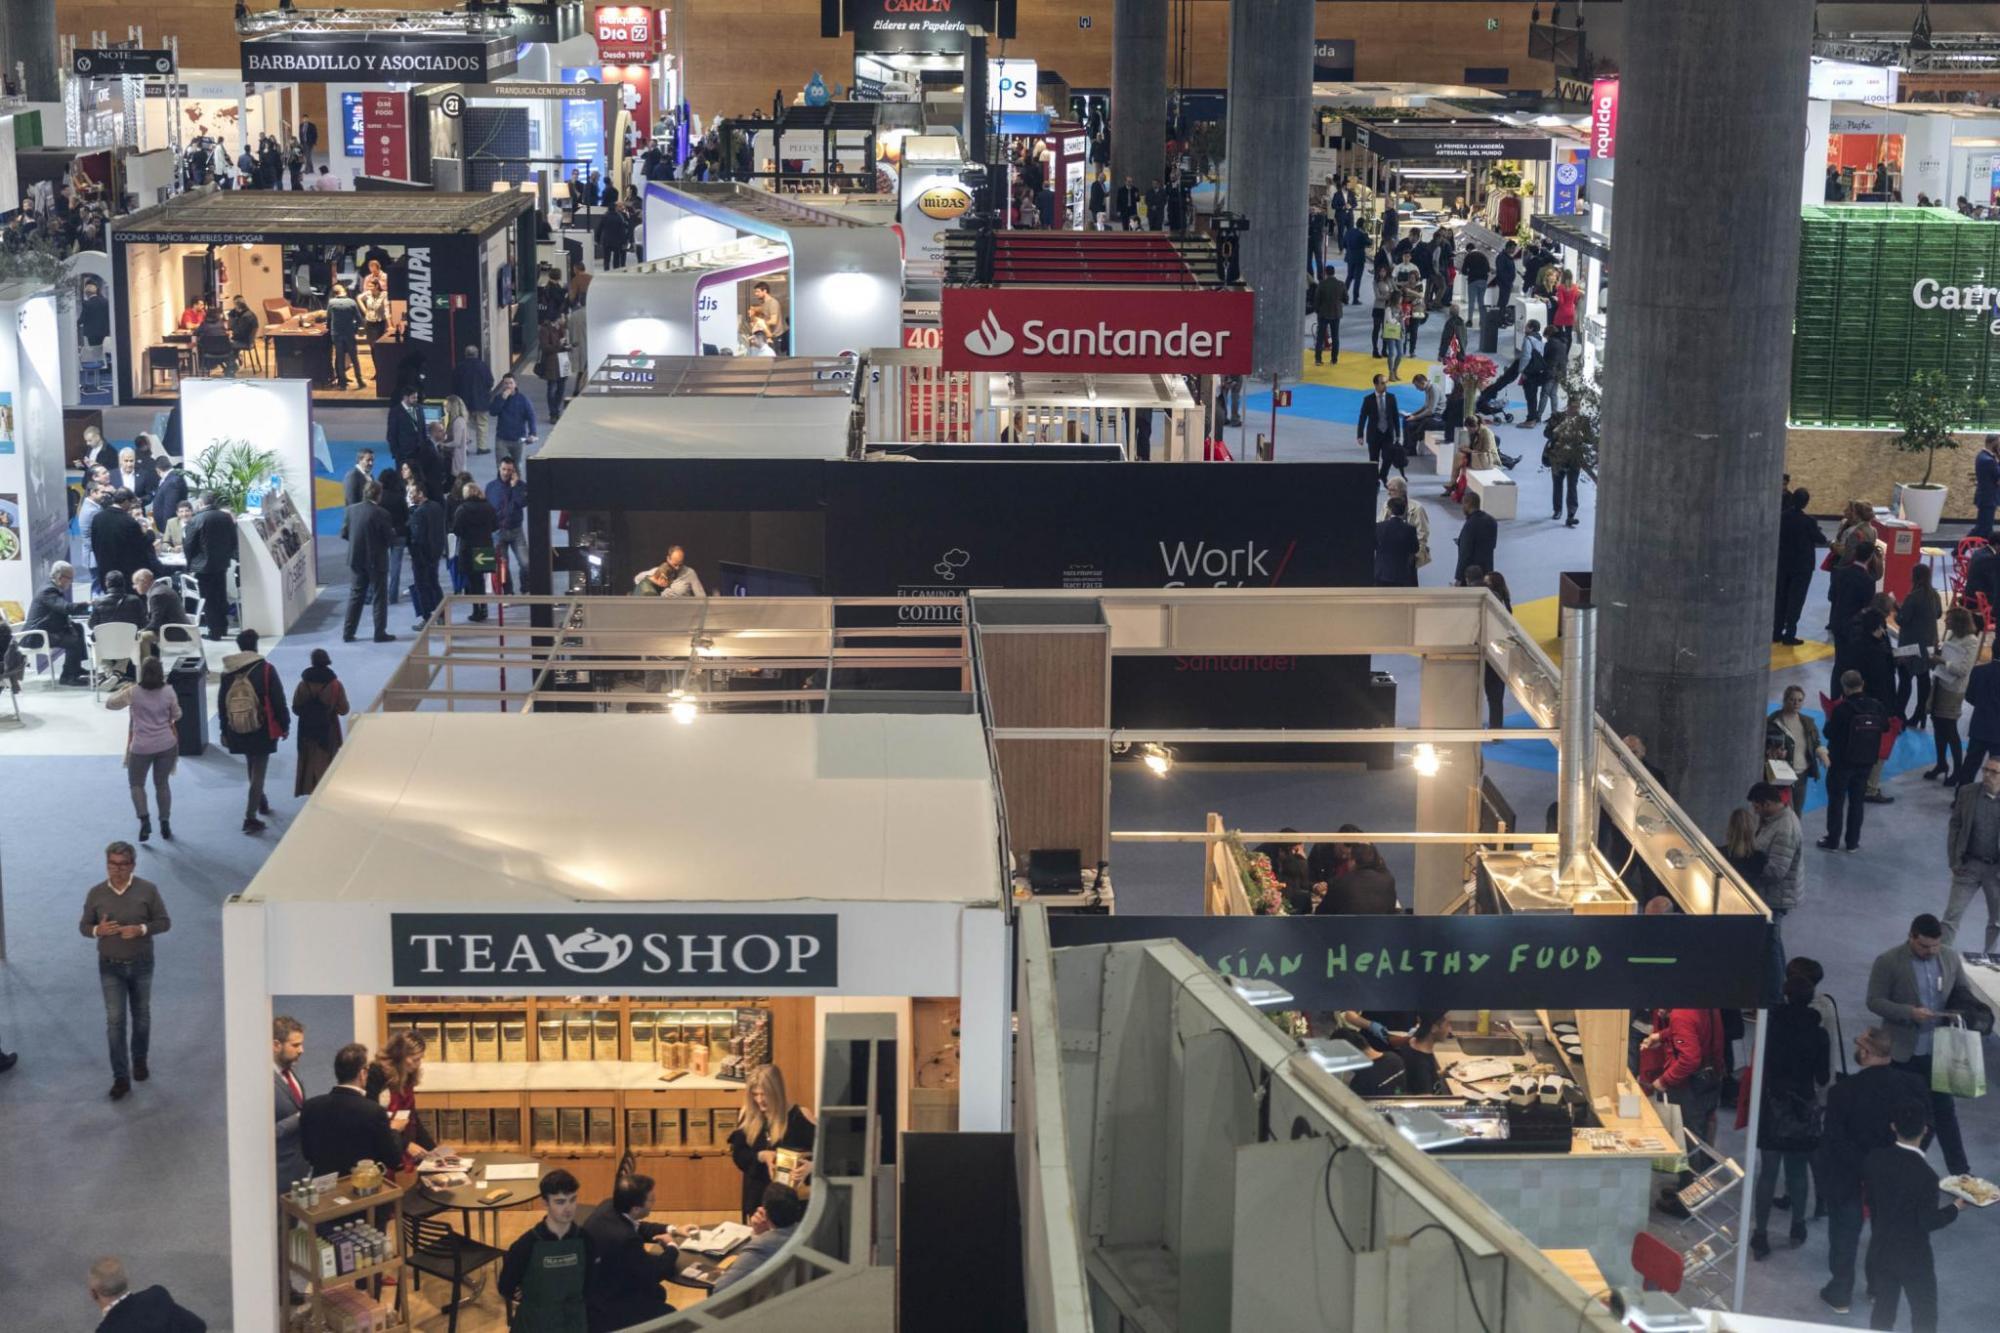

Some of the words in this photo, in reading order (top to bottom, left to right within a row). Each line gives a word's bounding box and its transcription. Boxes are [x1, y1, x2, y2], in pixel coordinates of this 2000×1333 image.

[538, 14, 551, 25] 21
[599, 15, 648, 25] Franquicia
[908, 22, 921, 30] en
[98, 51, 131, 60] NOTE
[602, 51, 626, 59] Desde
[628, 51, 646, 59] 1989
[248, 55, 361, 70] BARBADILLO
[364, 55, 377, 70] Y
[380, 56, 480, 70] ASOCIADOS
[115, 233, 150, 242] COCINAS
[156, 232, 184, 242] BAÑOS
[190, 233, 222, 242] MUEBLES
[224, 233, 234, 242] DE
[236, 233, 264, 242] HOGAR
[408, 247, 433, 342] MOBALPA
[1913, 278, 2000, 310] Carr
[1022, 320, 1231, 357] Santander
[1159, 541, 1269, 577] Work
[410, 934, 546, 973] TEA
[642, 933, 820, 973] SHOP
